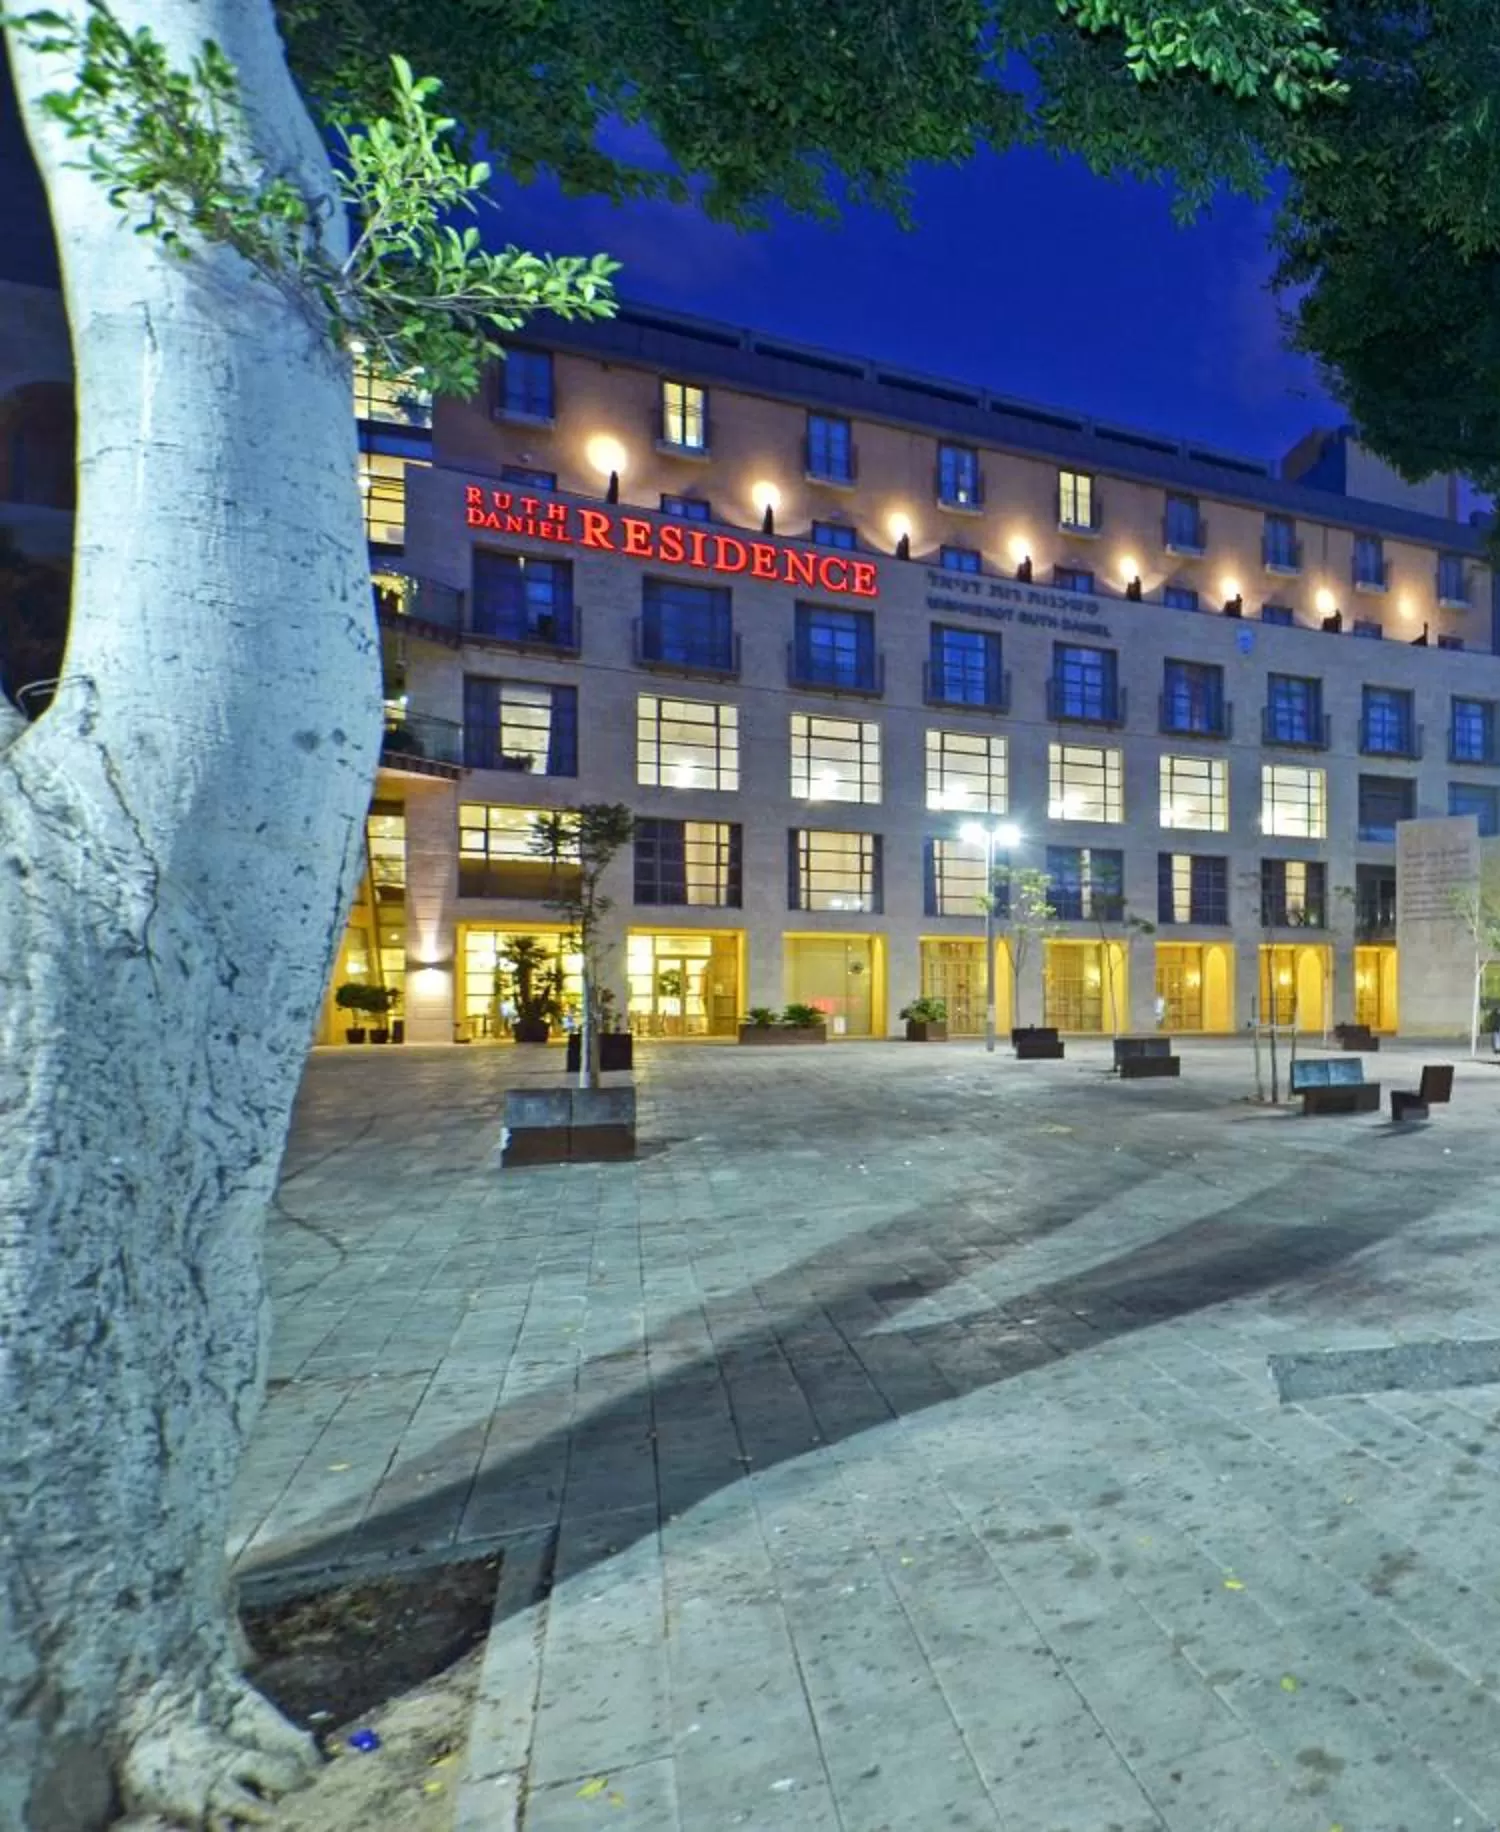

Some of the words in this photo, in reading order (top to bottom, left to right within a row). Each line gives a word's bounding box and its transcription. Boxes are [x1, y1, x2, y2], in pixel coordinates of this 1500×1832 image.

[466, 486, 568, 521] RUTH
[467, 507, 572, 543] DANIEL
[577, 508, 879, 597] RESIDENCE
